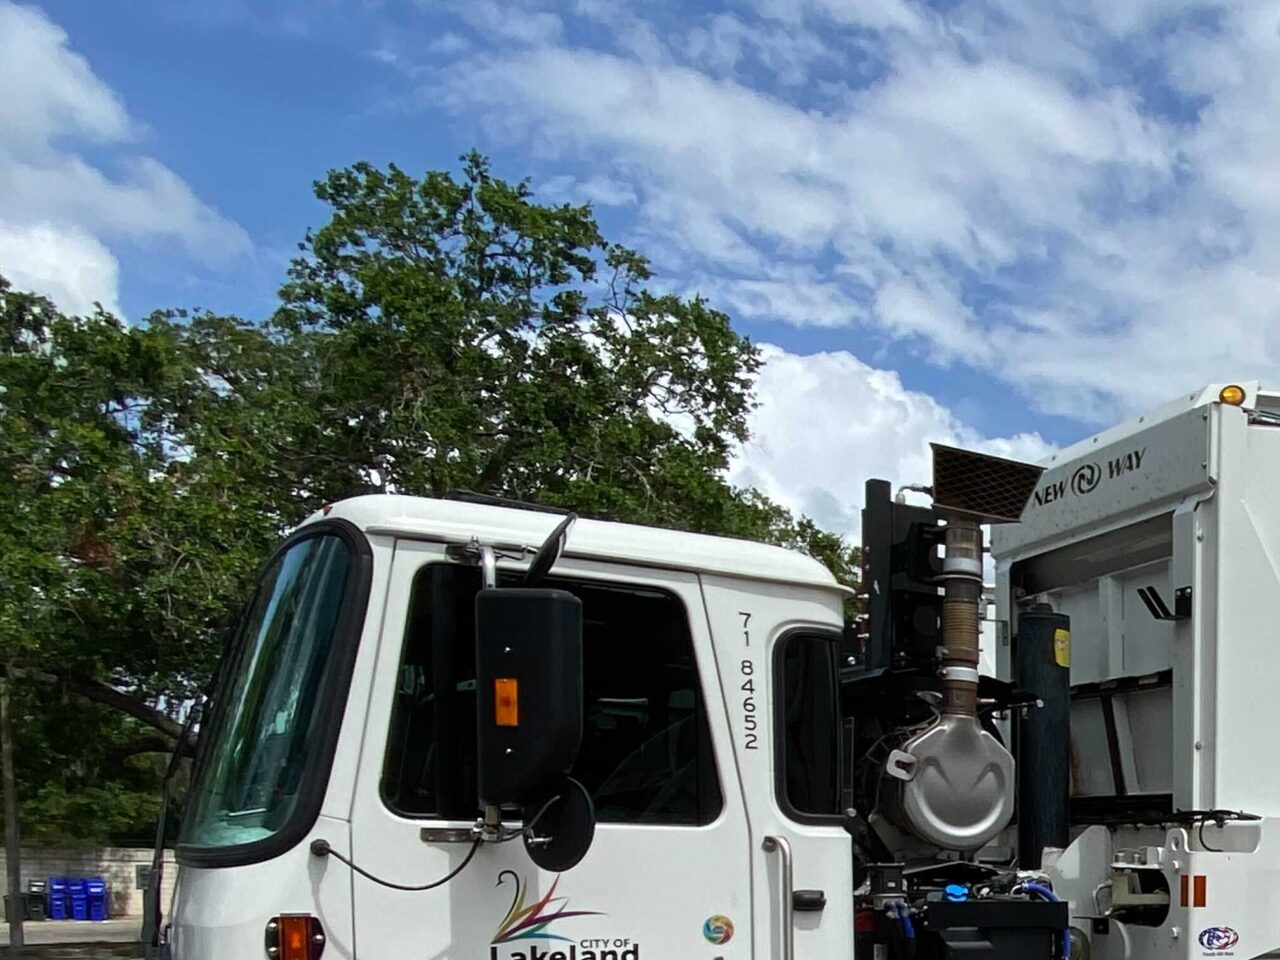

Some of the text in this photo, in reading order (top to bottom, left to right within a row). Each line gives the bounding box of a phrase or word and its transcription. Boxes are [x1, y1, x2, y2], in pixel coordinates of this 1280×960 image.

[1033, 477, 1068, 507] NEW
[1108, 447, 1146, 479] WAY
[580, 938, 630, 949] CITY OF
